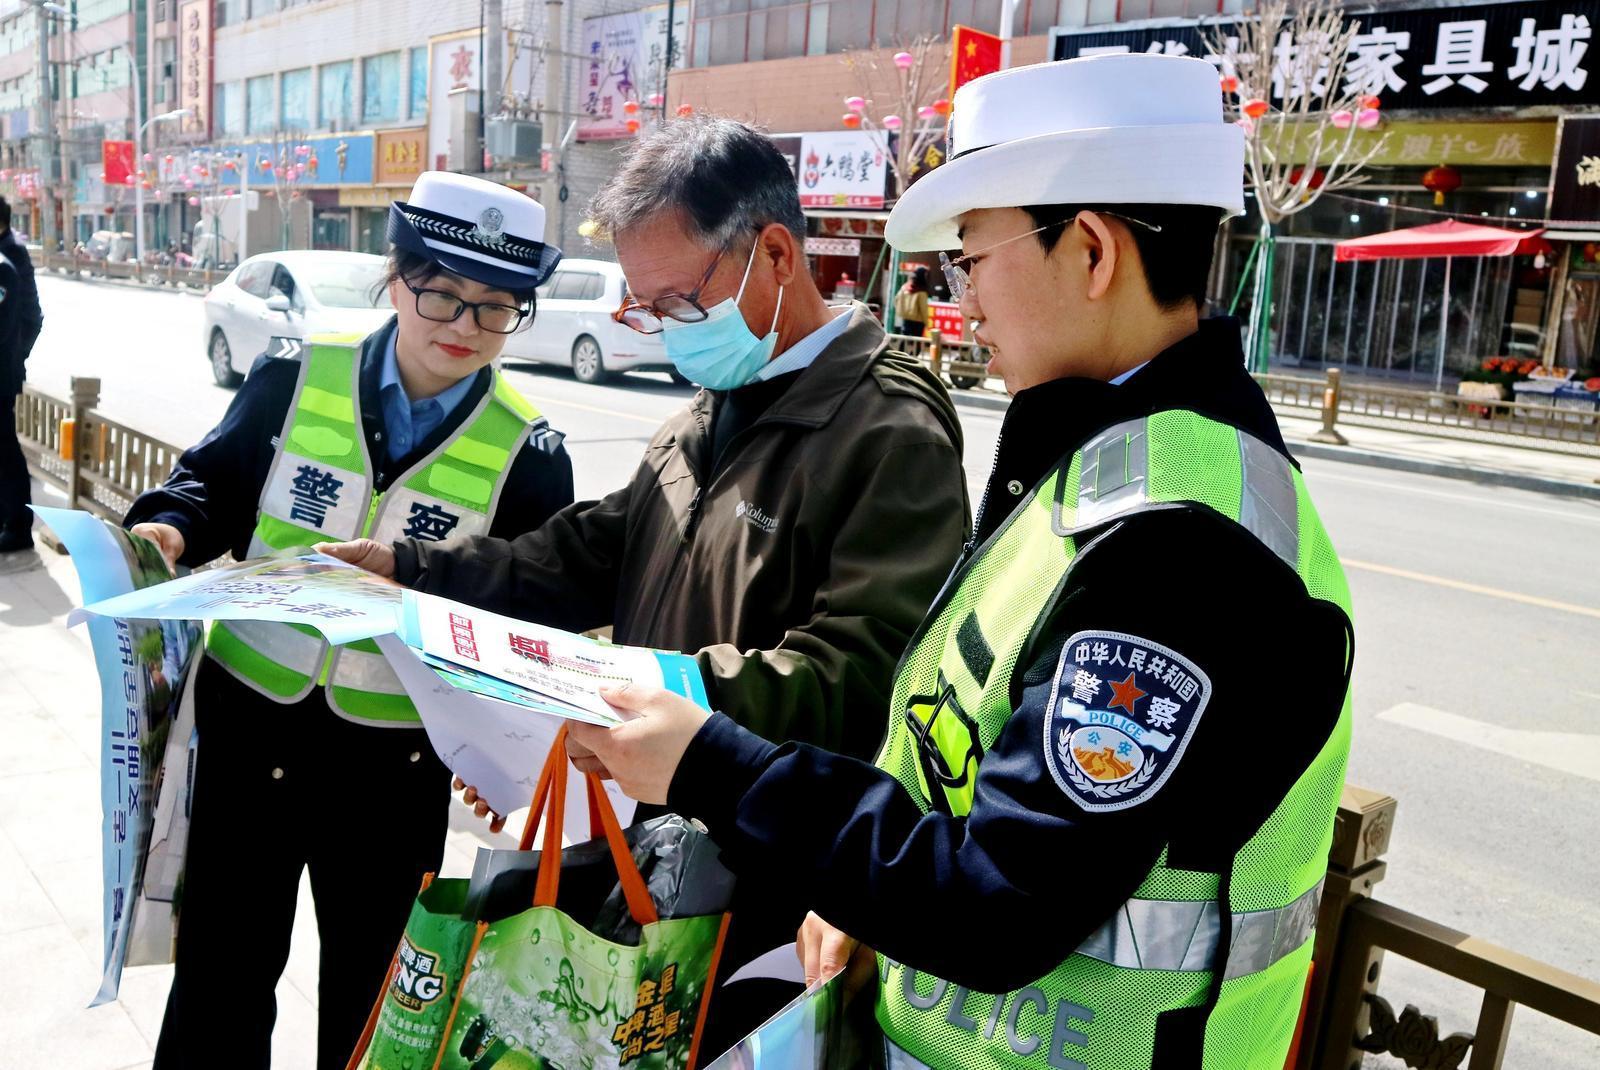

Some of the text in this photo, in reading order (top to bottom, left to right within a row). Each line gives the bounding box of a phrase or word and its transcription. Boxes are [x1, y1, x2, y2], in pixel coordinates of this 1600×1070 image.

[1078, 14, 1592, 98] 大楼家具城
[289, 464, 460, 542] 警 察
[1071, 669, 1182, 731] 警 察
[1074, 641, 1200, 703] 中华人民共和国
[1087, 730, 1133, 757] 公 安
[1088, 711, 1146, 741] POLICE
